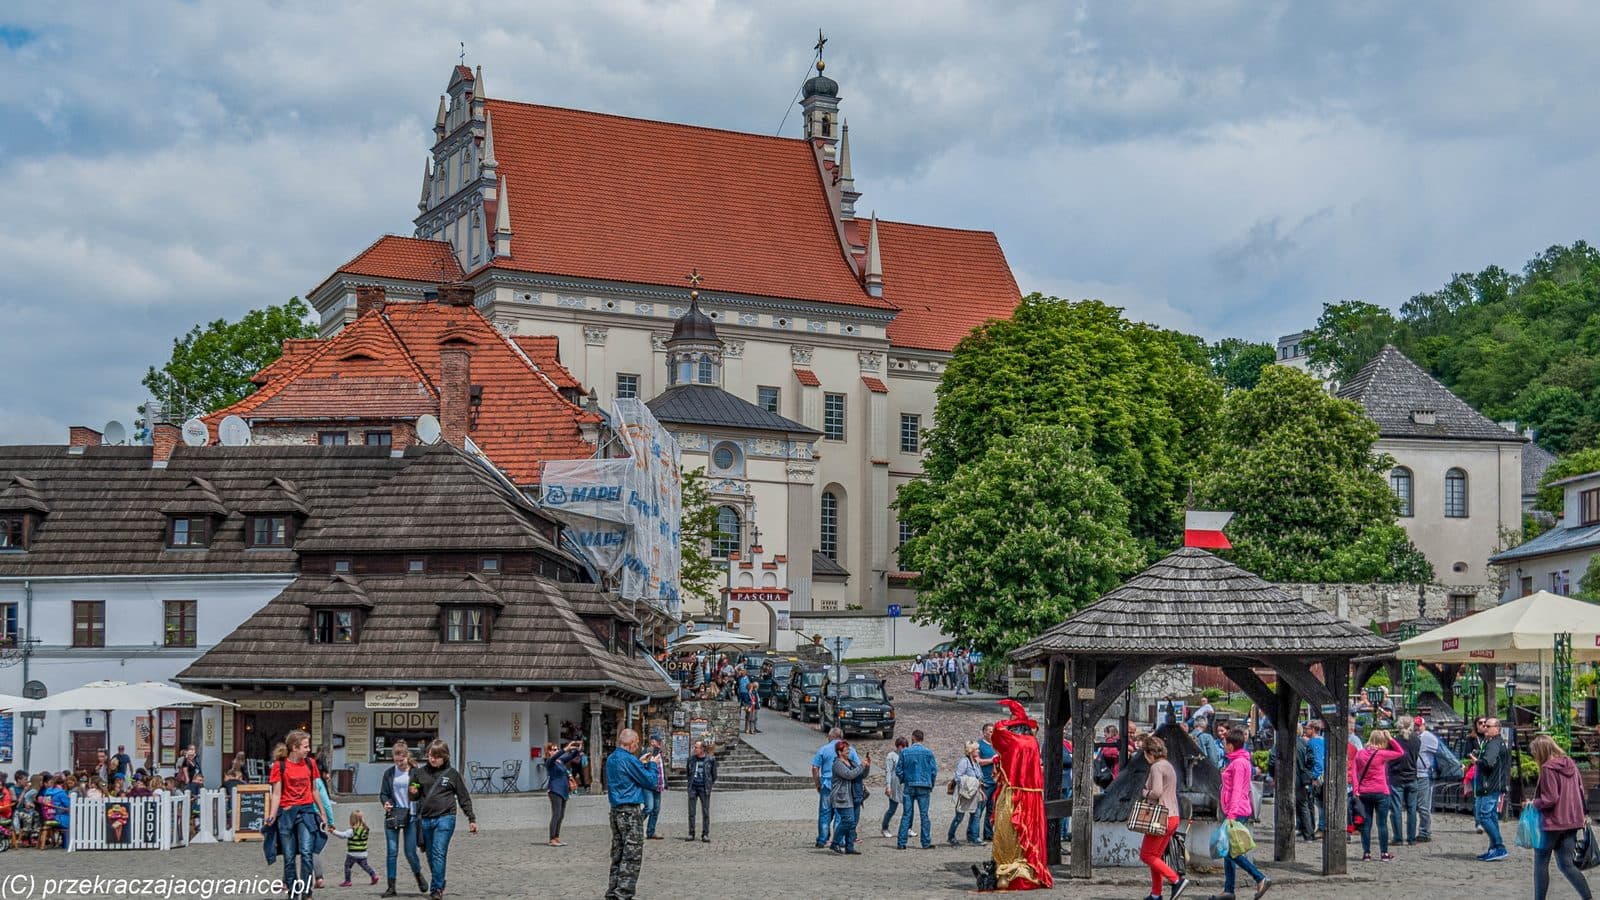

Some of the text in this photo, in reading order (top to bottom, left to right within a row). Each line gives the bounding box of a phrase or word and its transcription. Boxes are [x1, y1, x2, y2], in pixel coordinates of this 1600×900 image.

[571, 485, 622, 502] MAPEI
[737, 593, 781, 601] PASCHA
[259, 701, 286, 709] LODY
[347, 716, 368, 724] LODY
[380, 713, 436, 726] LODY
[513, 712, 521, 736] LODY
[146, 801, 154, 841] LODY
